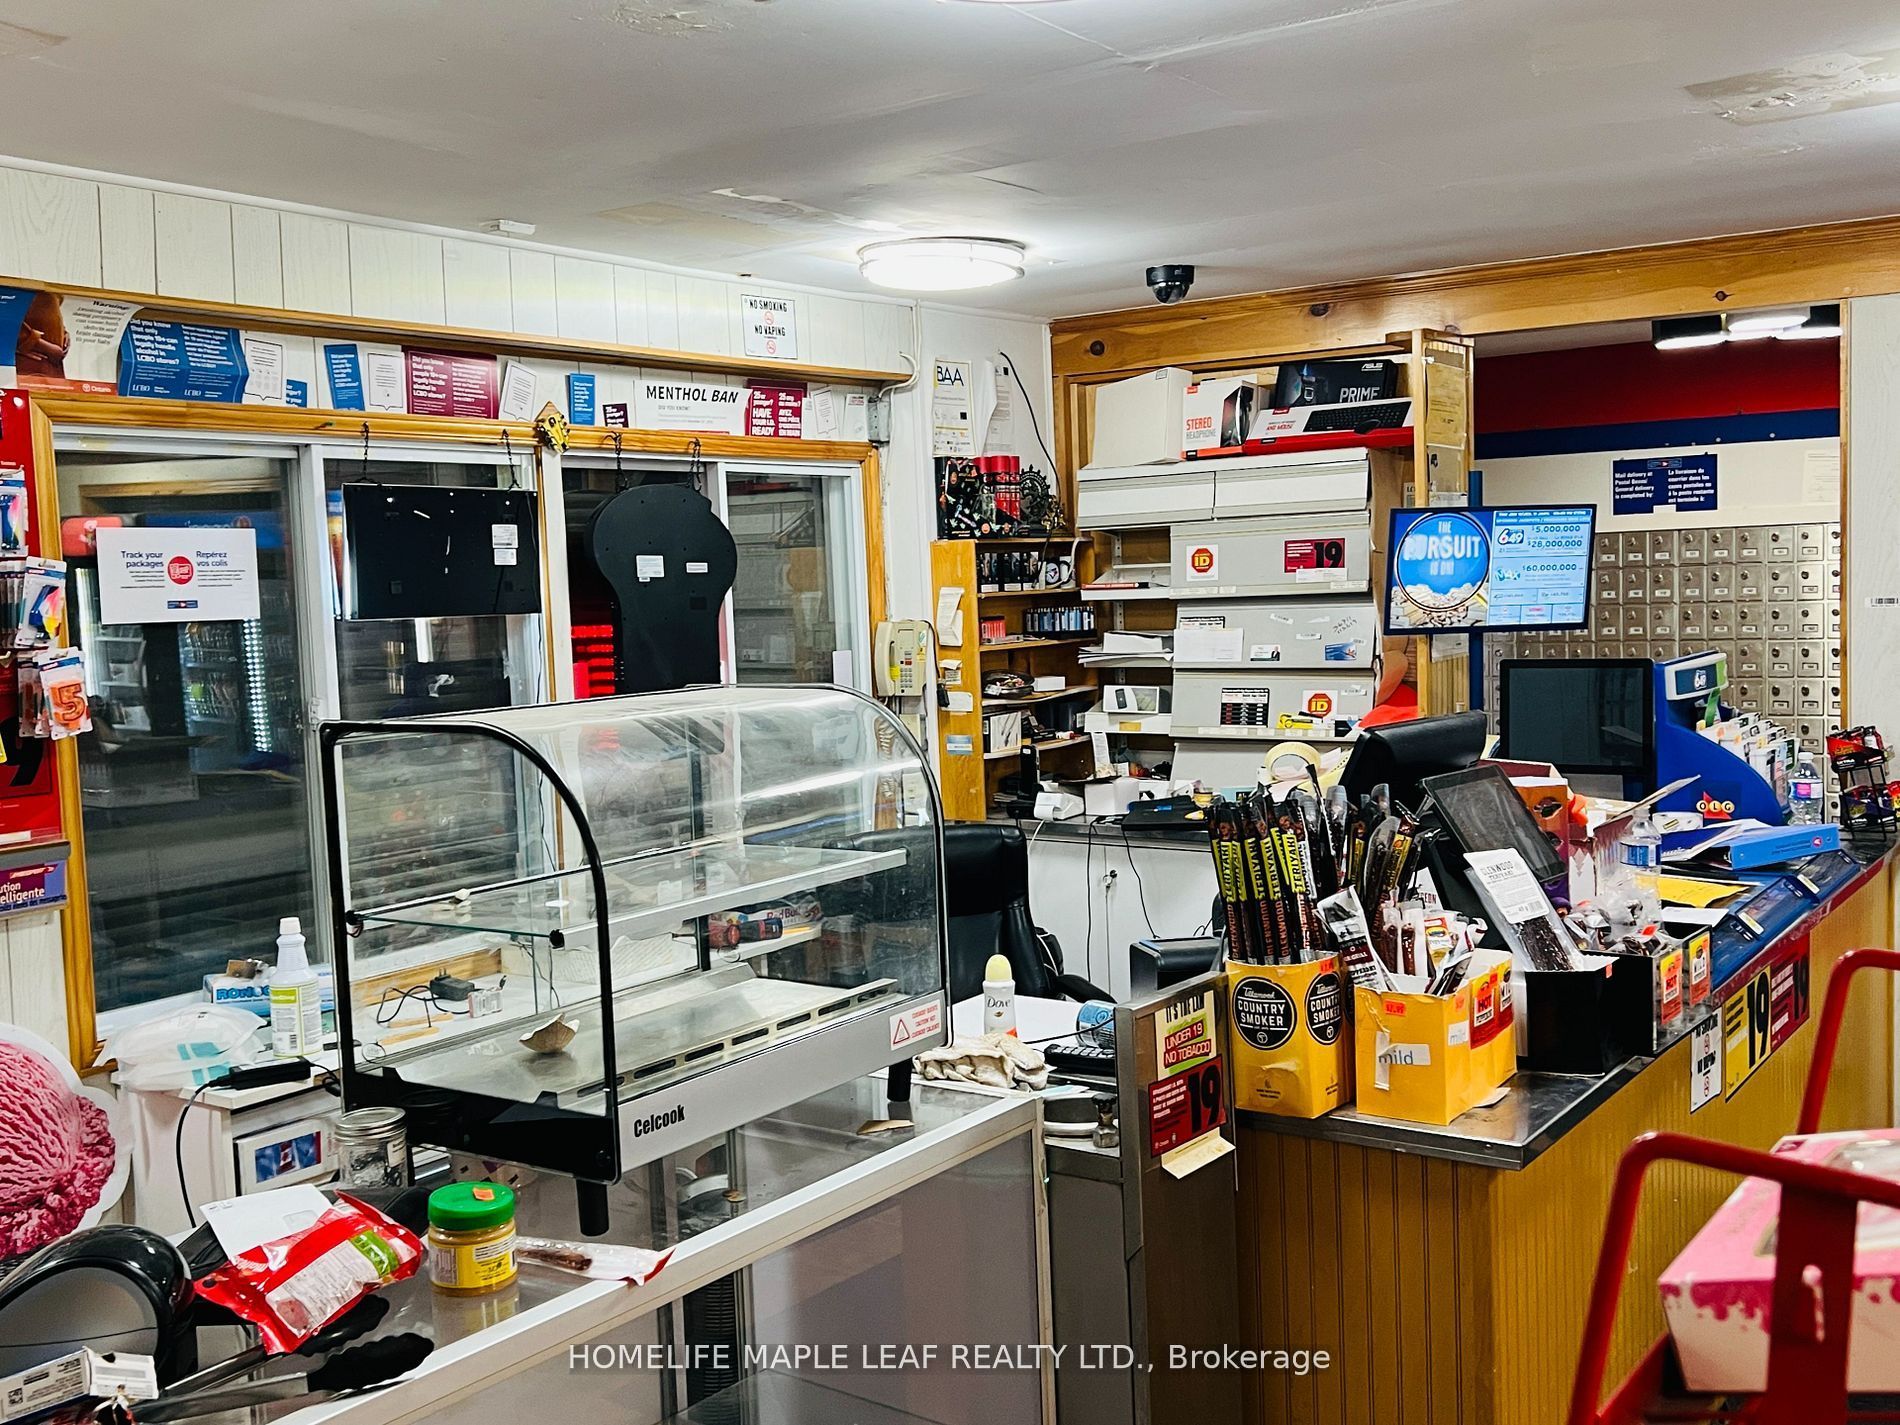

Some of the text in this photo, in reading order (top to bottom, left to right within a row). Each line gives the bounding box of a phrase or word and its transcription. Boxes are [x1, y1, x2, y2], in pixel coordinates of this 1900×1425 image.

[749, 299, 787, 312] NO SMOKING
[754, 325, 786, 336] NO VAPING
[646, 385, 739, 404] MENTHOL BAN
[752, 408, 773, 419] HAVE
[1186, 416, 1213, 431] STEREO
[751, 426, 774, 436] READY
[1438, 520, 1452, 534] THE
[1531, 524, 1581, 534] $5,000,000
[1527, 539, 1583, 549] $28,000,000
[120, 550, 163, 560] Track your
[196, 550, 228, 561] Repérez
[1313, 541, 1343, 568] 19
[126, 559, 165, 568] packages
[211, 559, 228, 567] colis
[1522, 563, 1577, 573] $60,000,000
[1696, 800, 1735, 813] OLG
[1264, 840, 1281, 900] TERIYAKI
[1286, 836, 1304, 890] TERIYAKI
[986, 996, 1011, 1008] Dove
[1237, 1000, 1286, 1014] COUNTRY
[1240, 1012, 1284, 1027] SMOKER
[1747, 971, 1770, 1069] 19
[1165, 1022, 1204, 1050] UNDER 19
[1165, 1042, 1211, 1065] NO TOBACCO
[1378, 1050, 1414, 1066] mild
[1188, 1064, 1221, 1135] 19
[633, 1104, 686, 1138] Celcook
